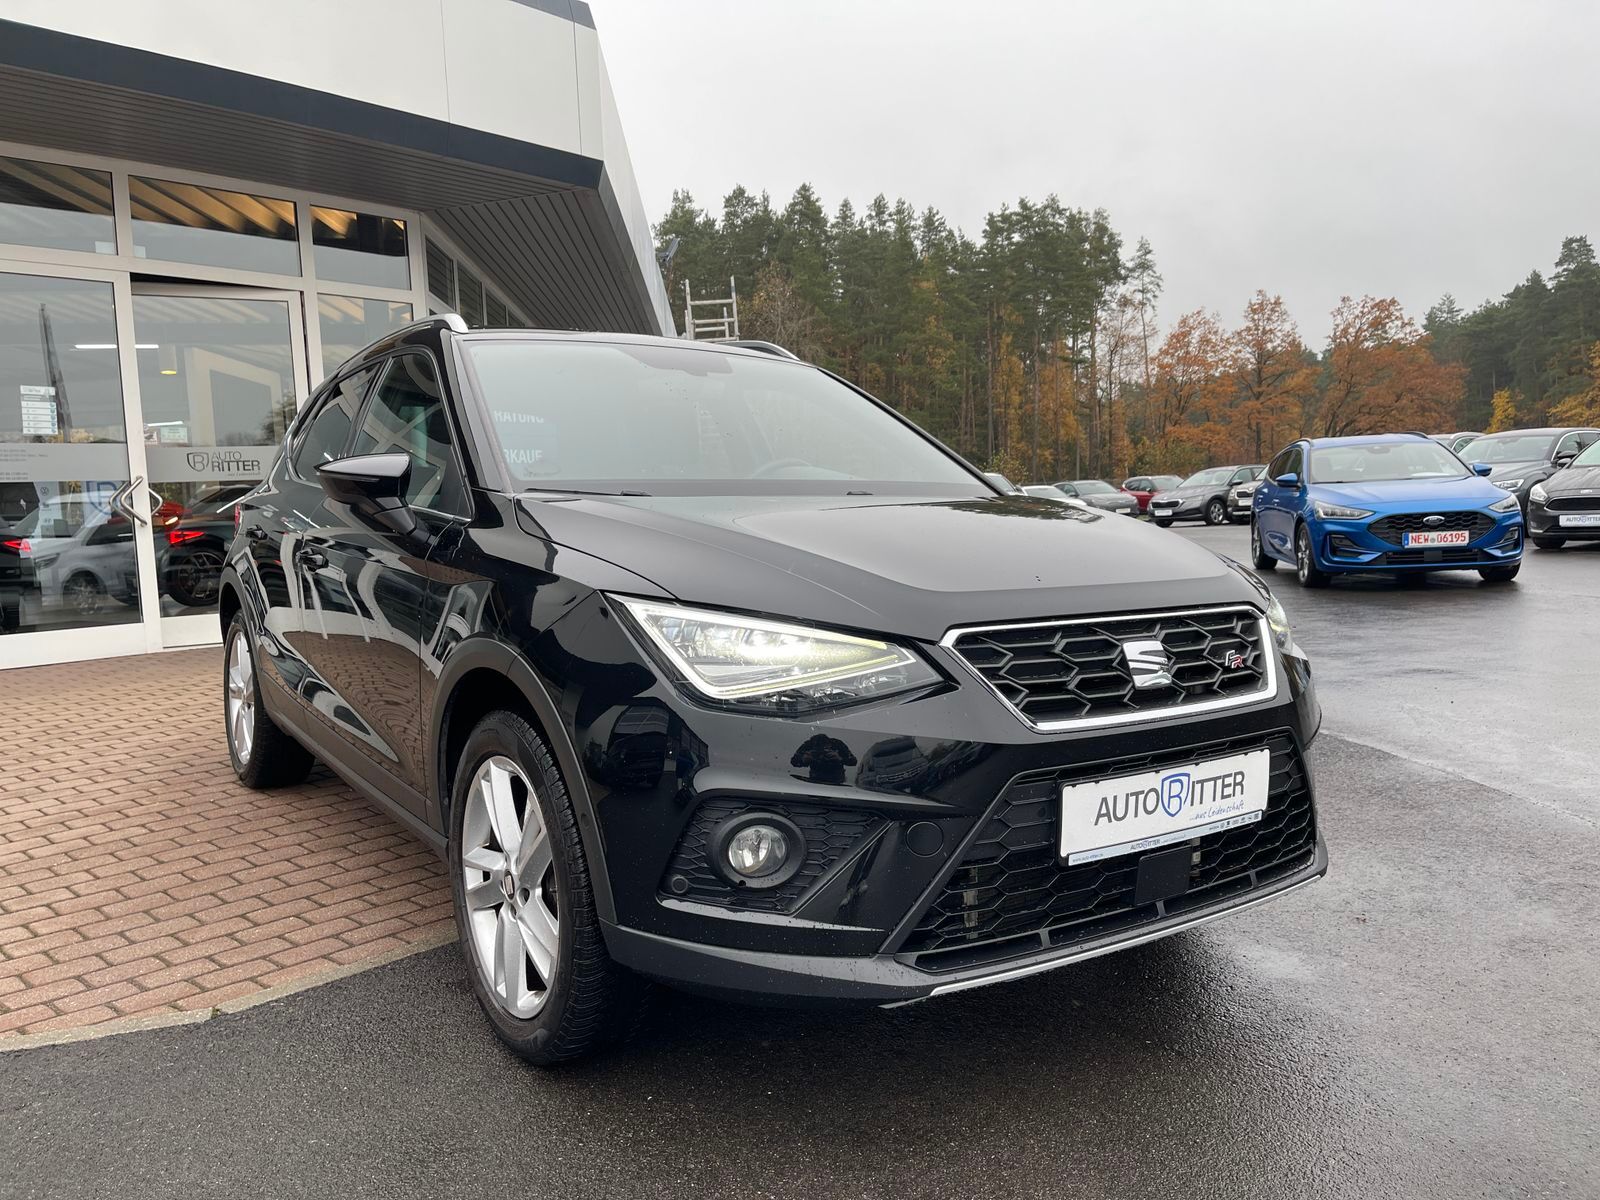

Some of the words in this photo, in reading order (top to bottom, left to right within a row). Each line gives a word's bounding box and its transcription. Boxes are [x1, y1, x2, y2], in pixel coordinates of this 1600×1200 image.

[211, 451, 242, 460] AUTO
[211, 460, 261, 472] RITTER
[1410, 535, 1430, 544] NEW
[1436, 532, 1467, 543] 06195
